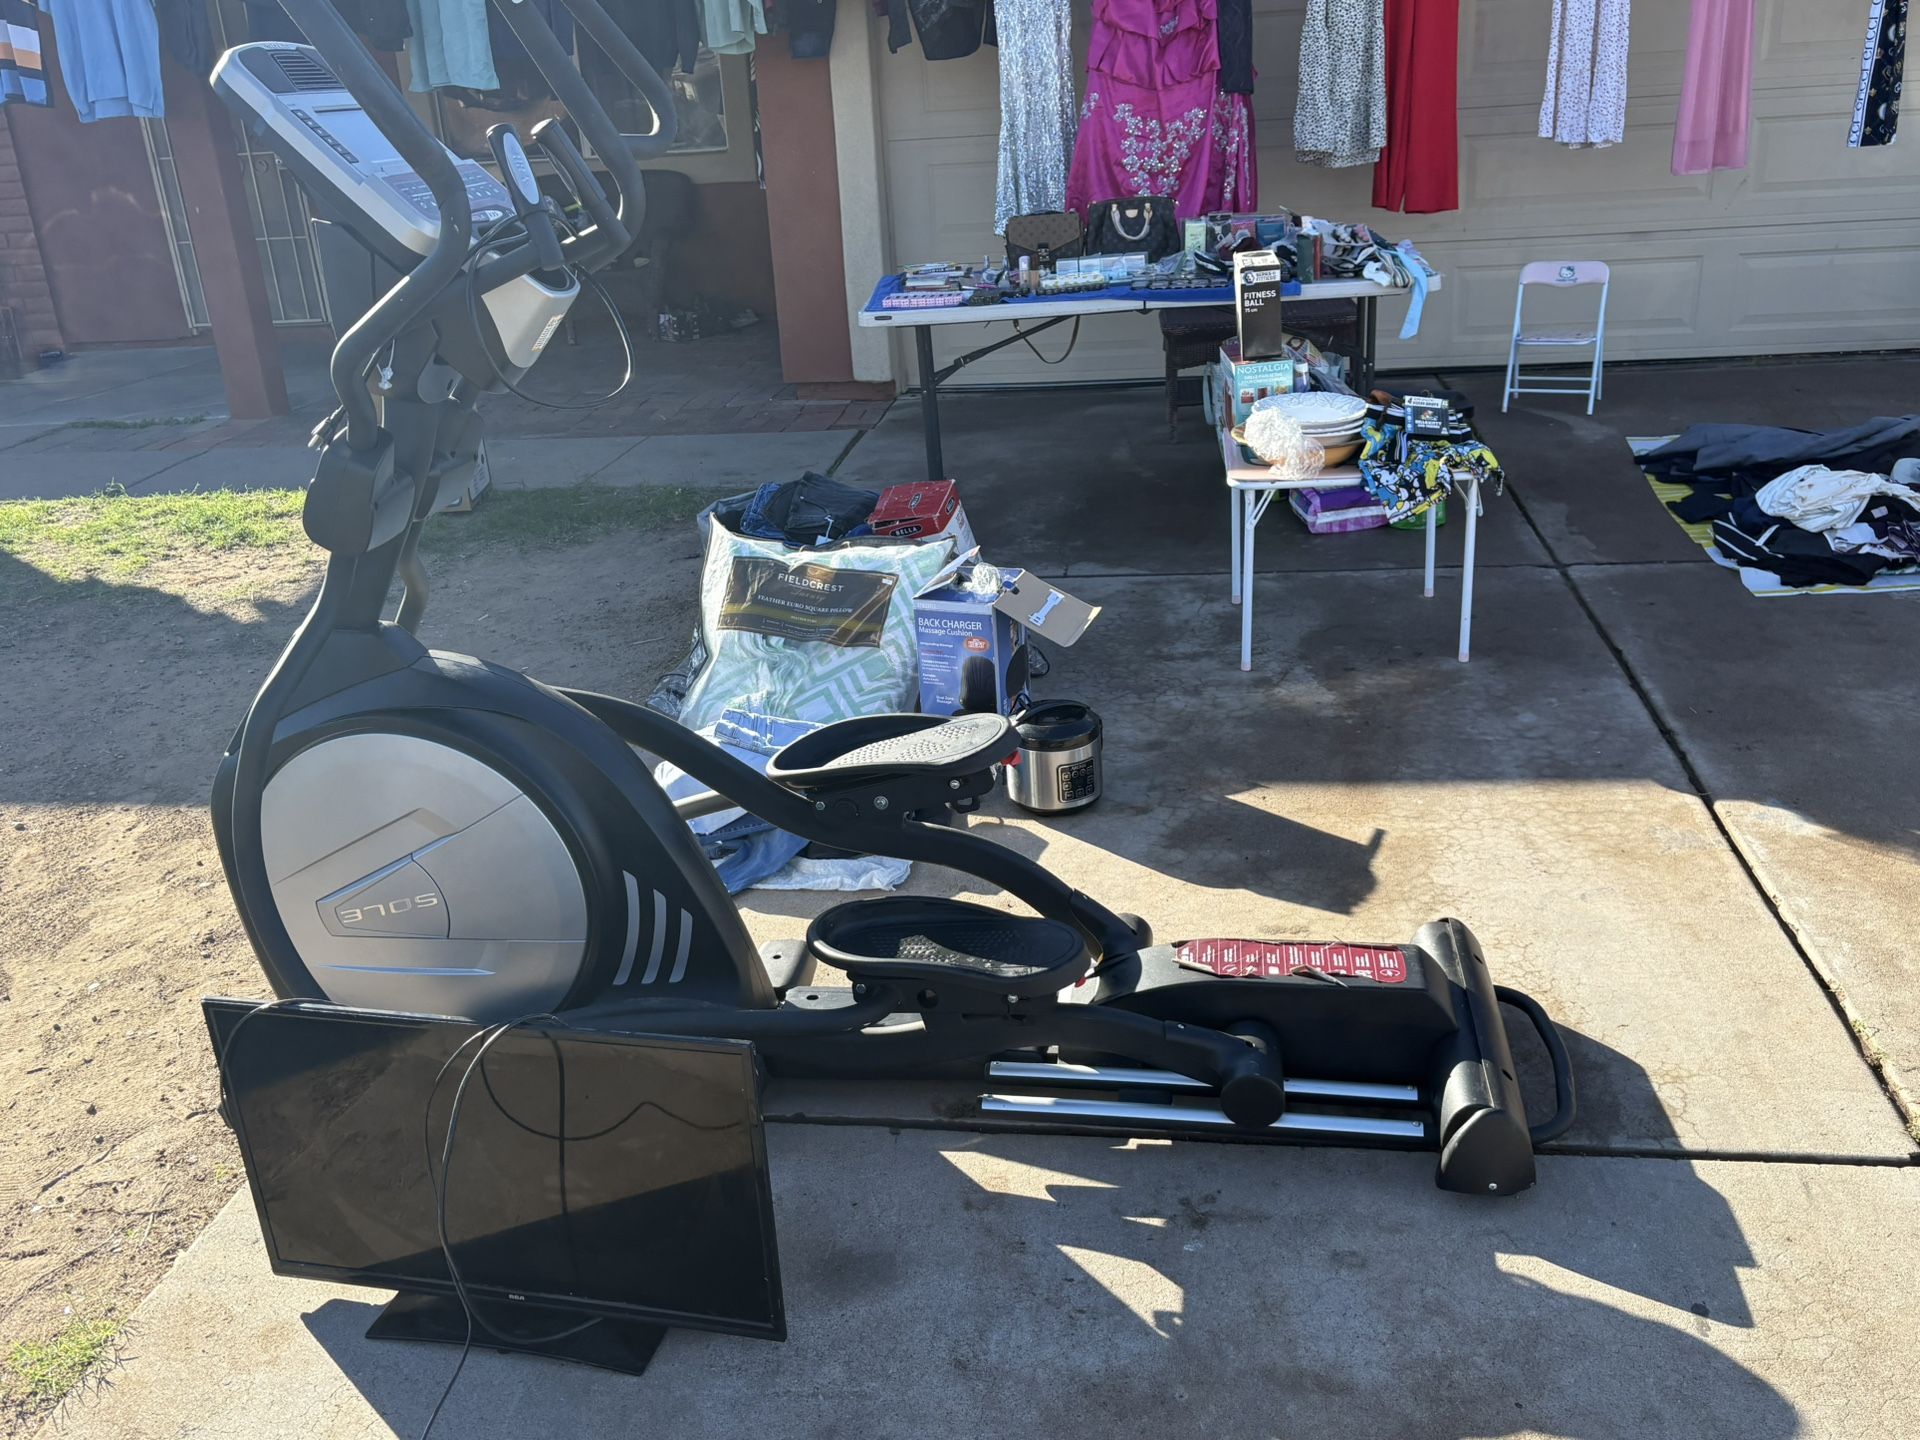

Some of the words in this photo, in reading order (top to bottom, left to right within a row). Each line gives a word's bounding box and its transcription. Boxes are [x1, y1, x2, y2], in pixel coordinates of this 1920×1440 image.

[1244, 290, 1277, 299] FITNESS
[1244, 299, 1264, 307] BALL
[1237, 363, 1290, 374] NOSTALGIA
[895, 527, 918, 536] BELLA
[778, 573, 844, 592] FIELDCREST
[758, 594, 786, 606] FEATHER
[787, 600, 805, 609] EURO
[805, 604, 829, 613] SQUARE
[918, 618, 940, 627] BACK
[941, 619, 982, 630] CHARGER
[919, 627, 946, 635] Massage
[946, 628, 973, 637] Cushion
[341, 893, 438, 923] SOLE
